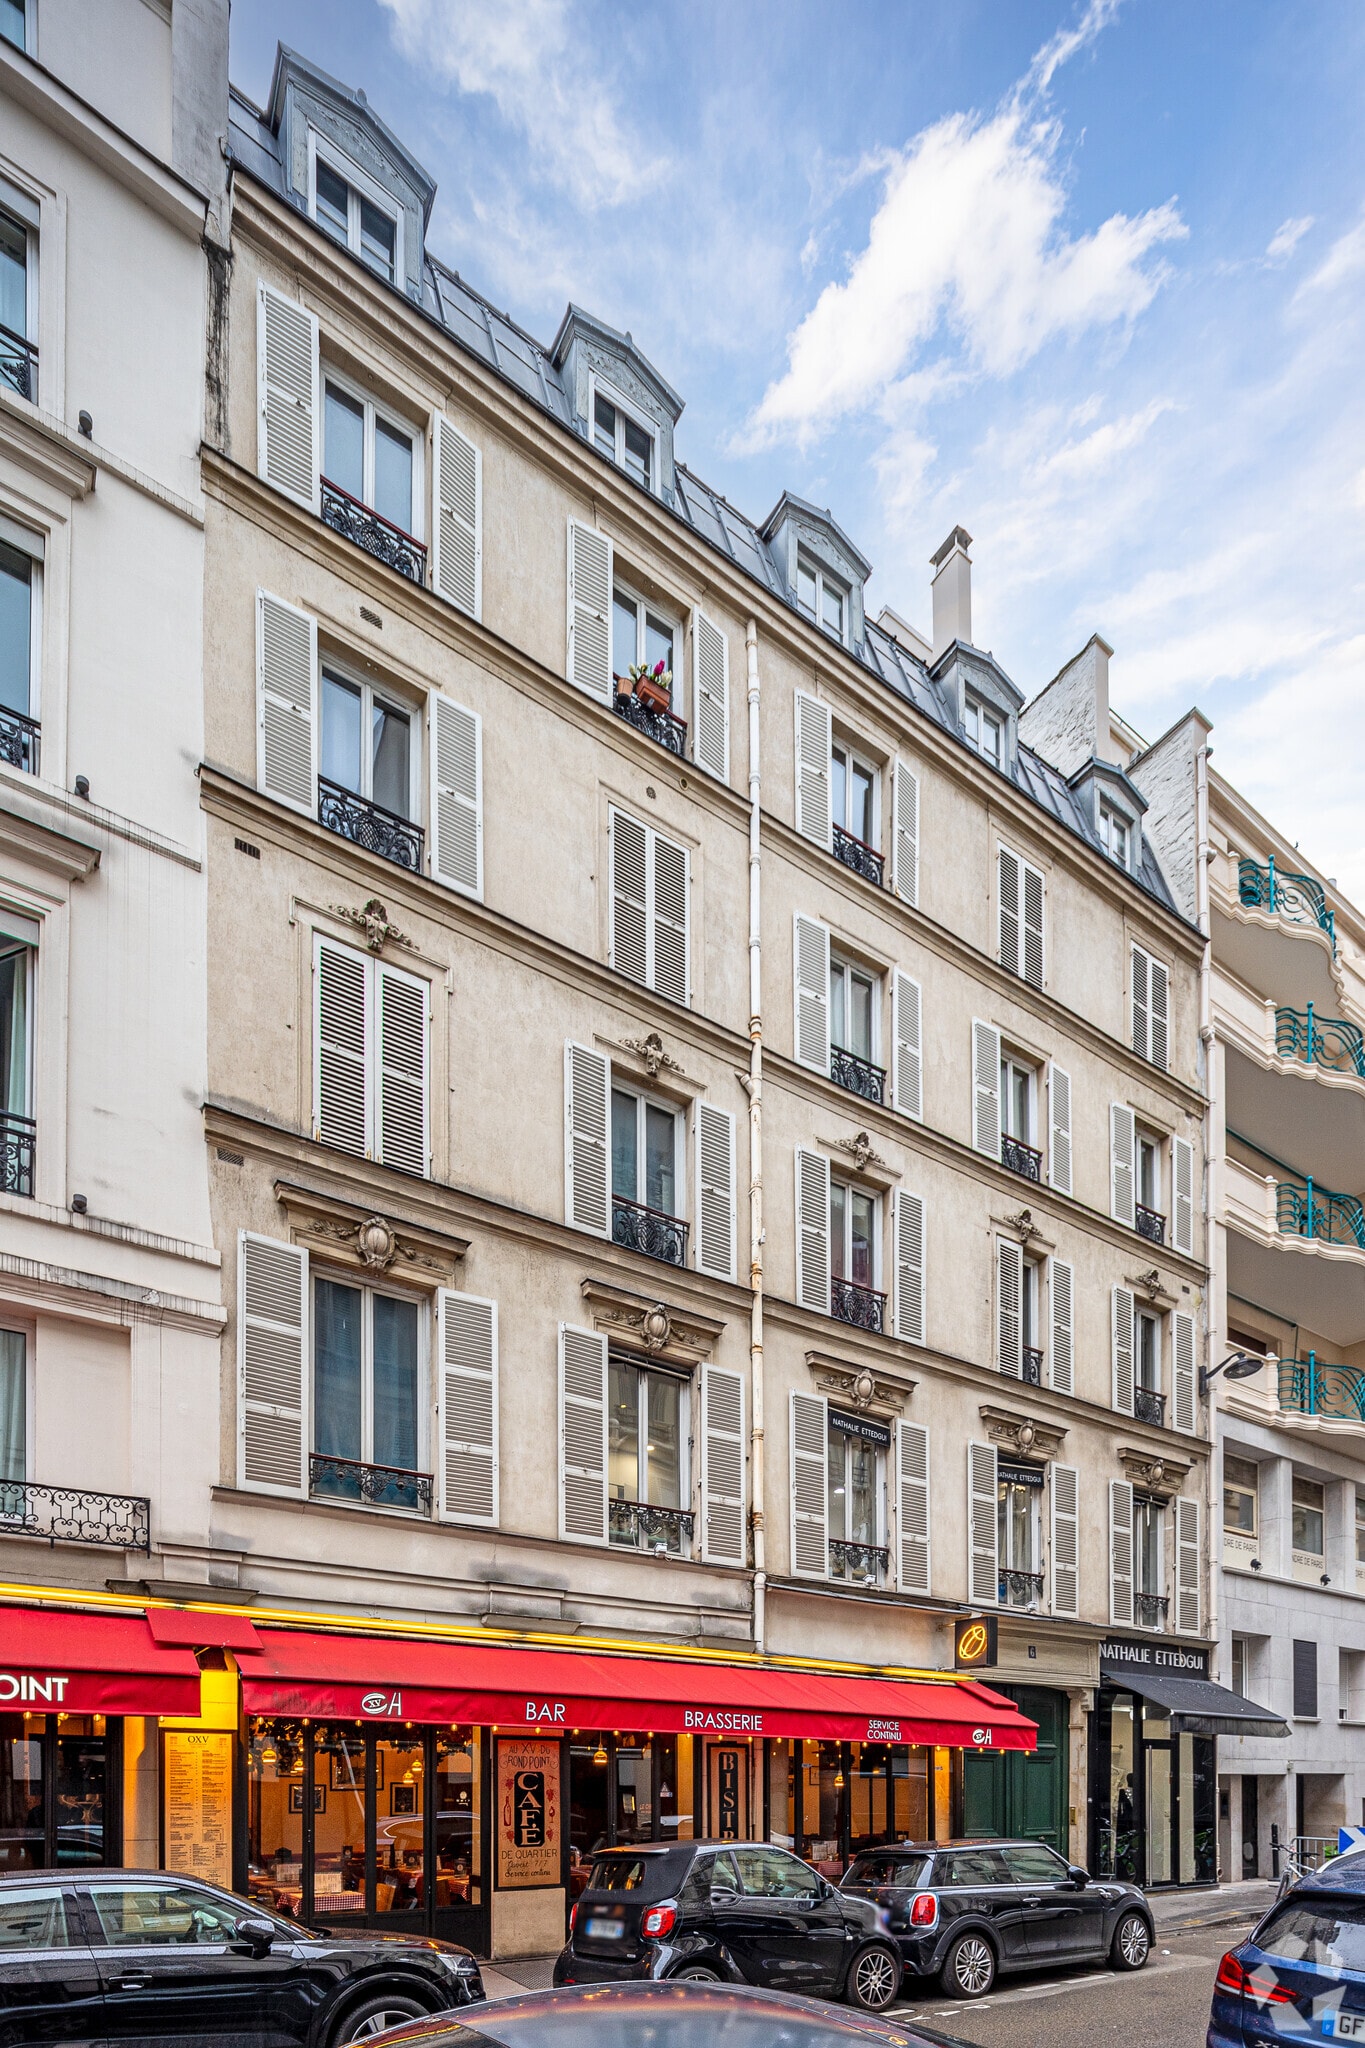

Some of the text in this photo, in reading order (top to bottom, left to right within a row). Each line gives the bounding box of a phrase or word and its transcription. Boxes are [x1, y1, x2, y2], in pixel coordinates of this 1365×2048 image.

[832, 1418, 888, 1442] NATHALIE ETTEDGUI
[1098, 1643, 1204, 1670] NATHALIE ETTEDGUI
[0, 1674, 69, 1702] OINT
[525, 1702, 566, 1722] BAR
[684, 1711, 763, 1731] BRASSERIE
[868, 1719, 900, 1731] SERVICE
[187, 1735, 209, 1744] OXV
[866, 1729, 902, 1741] CONTINU
[521, 1742, 536, 1754] XV
[529, 1756, 550, 1769] POINT
[501, 1848, 558, 1860] DE QUARTIER
[1339, 2015, 1365, 2035] GF
